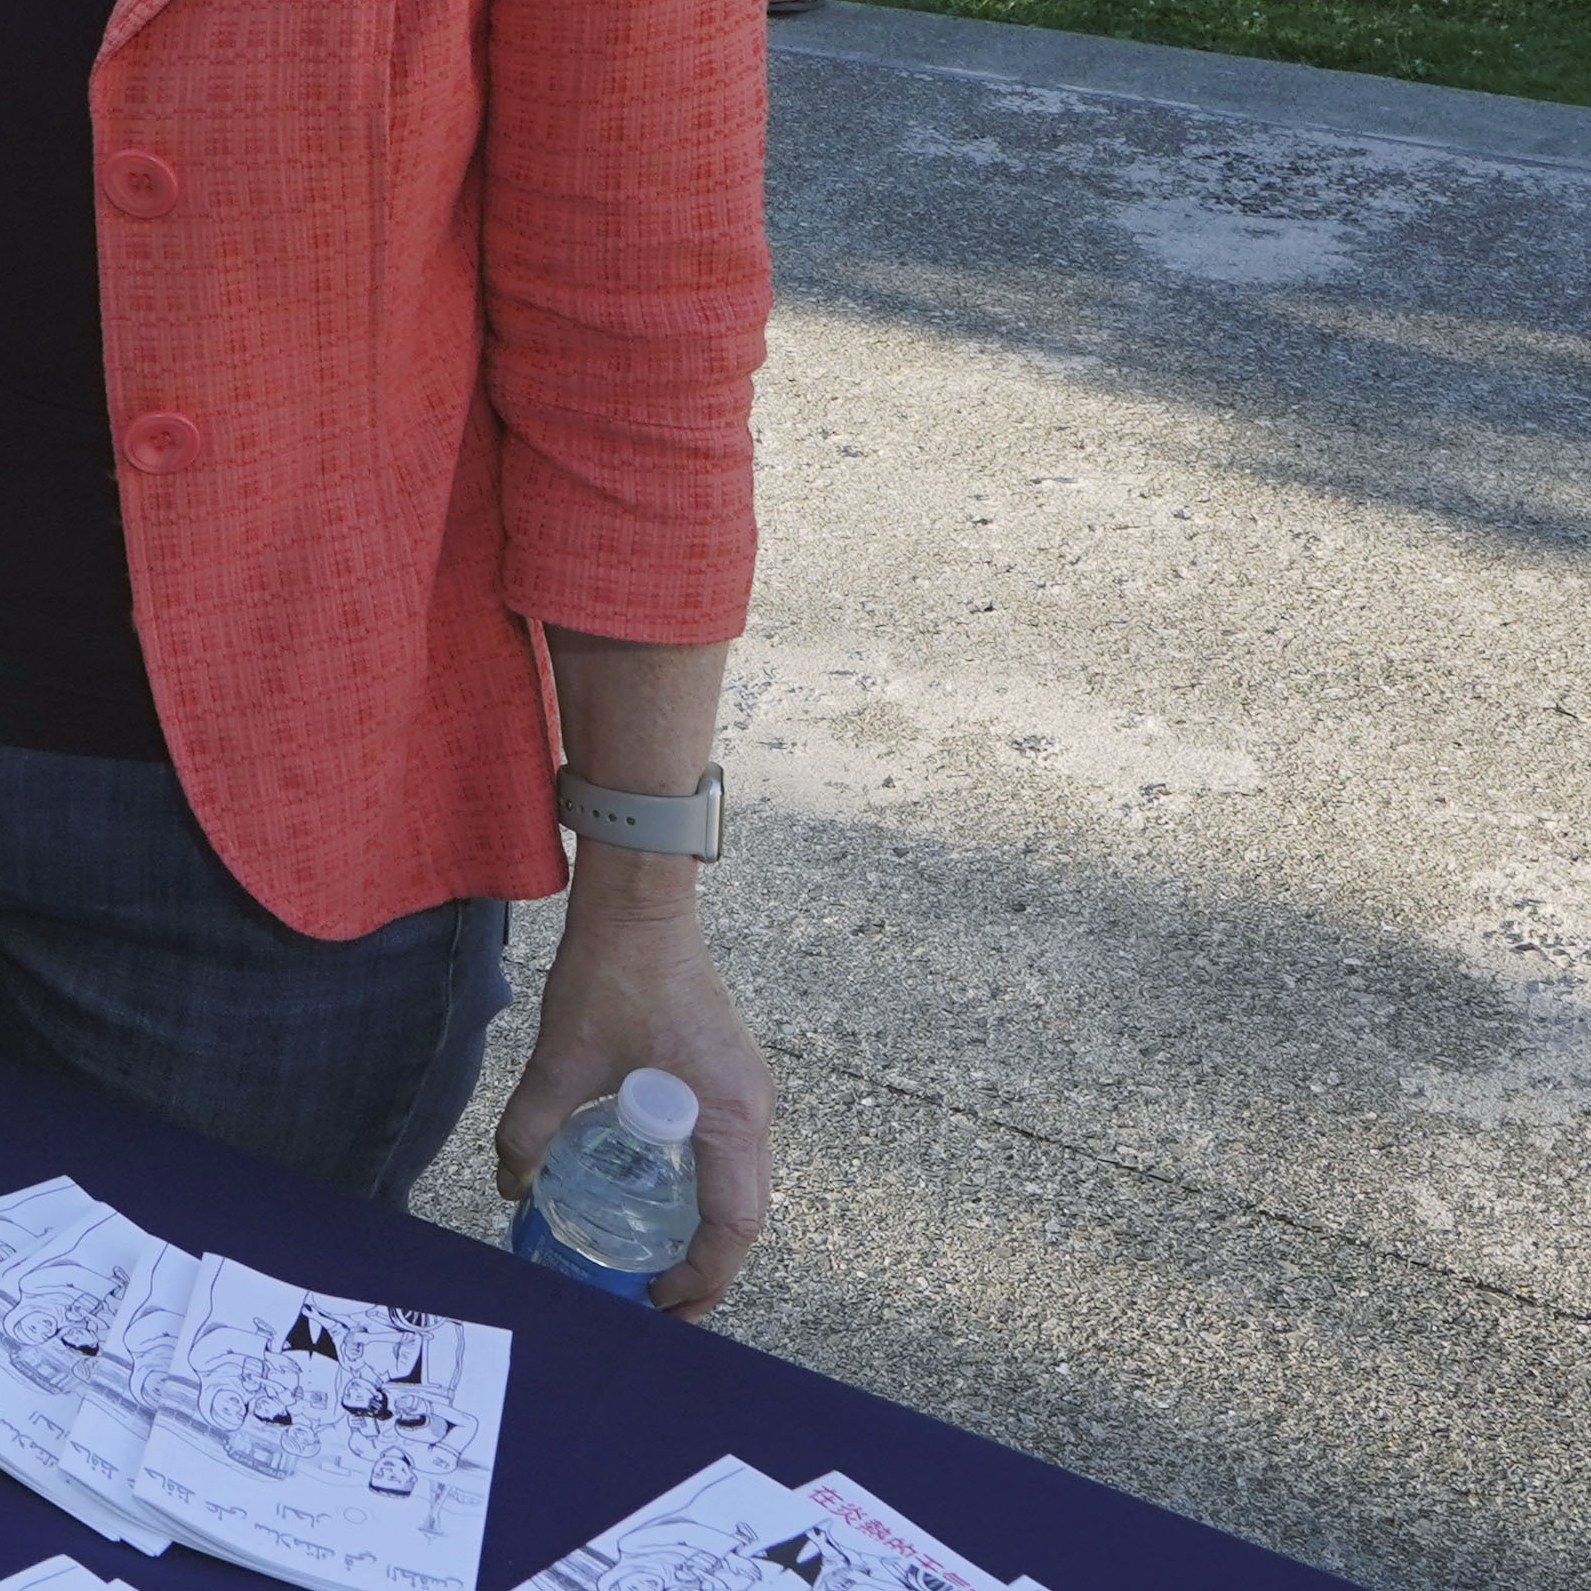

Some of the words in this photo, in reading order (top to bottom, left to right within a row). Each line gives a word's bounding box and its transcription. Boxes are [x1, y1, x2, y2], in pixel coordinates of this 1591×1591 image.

[144, 1466, 195, 1504] حافظ
[205, 1500, 248, 1521] على
[254, 1522, 336, 1560] سلامتك
[344, 1551, 377, 1571] في
[385, 1563, 464, 1591] الطقس
[275, 1502, 332, 1528] الحار
